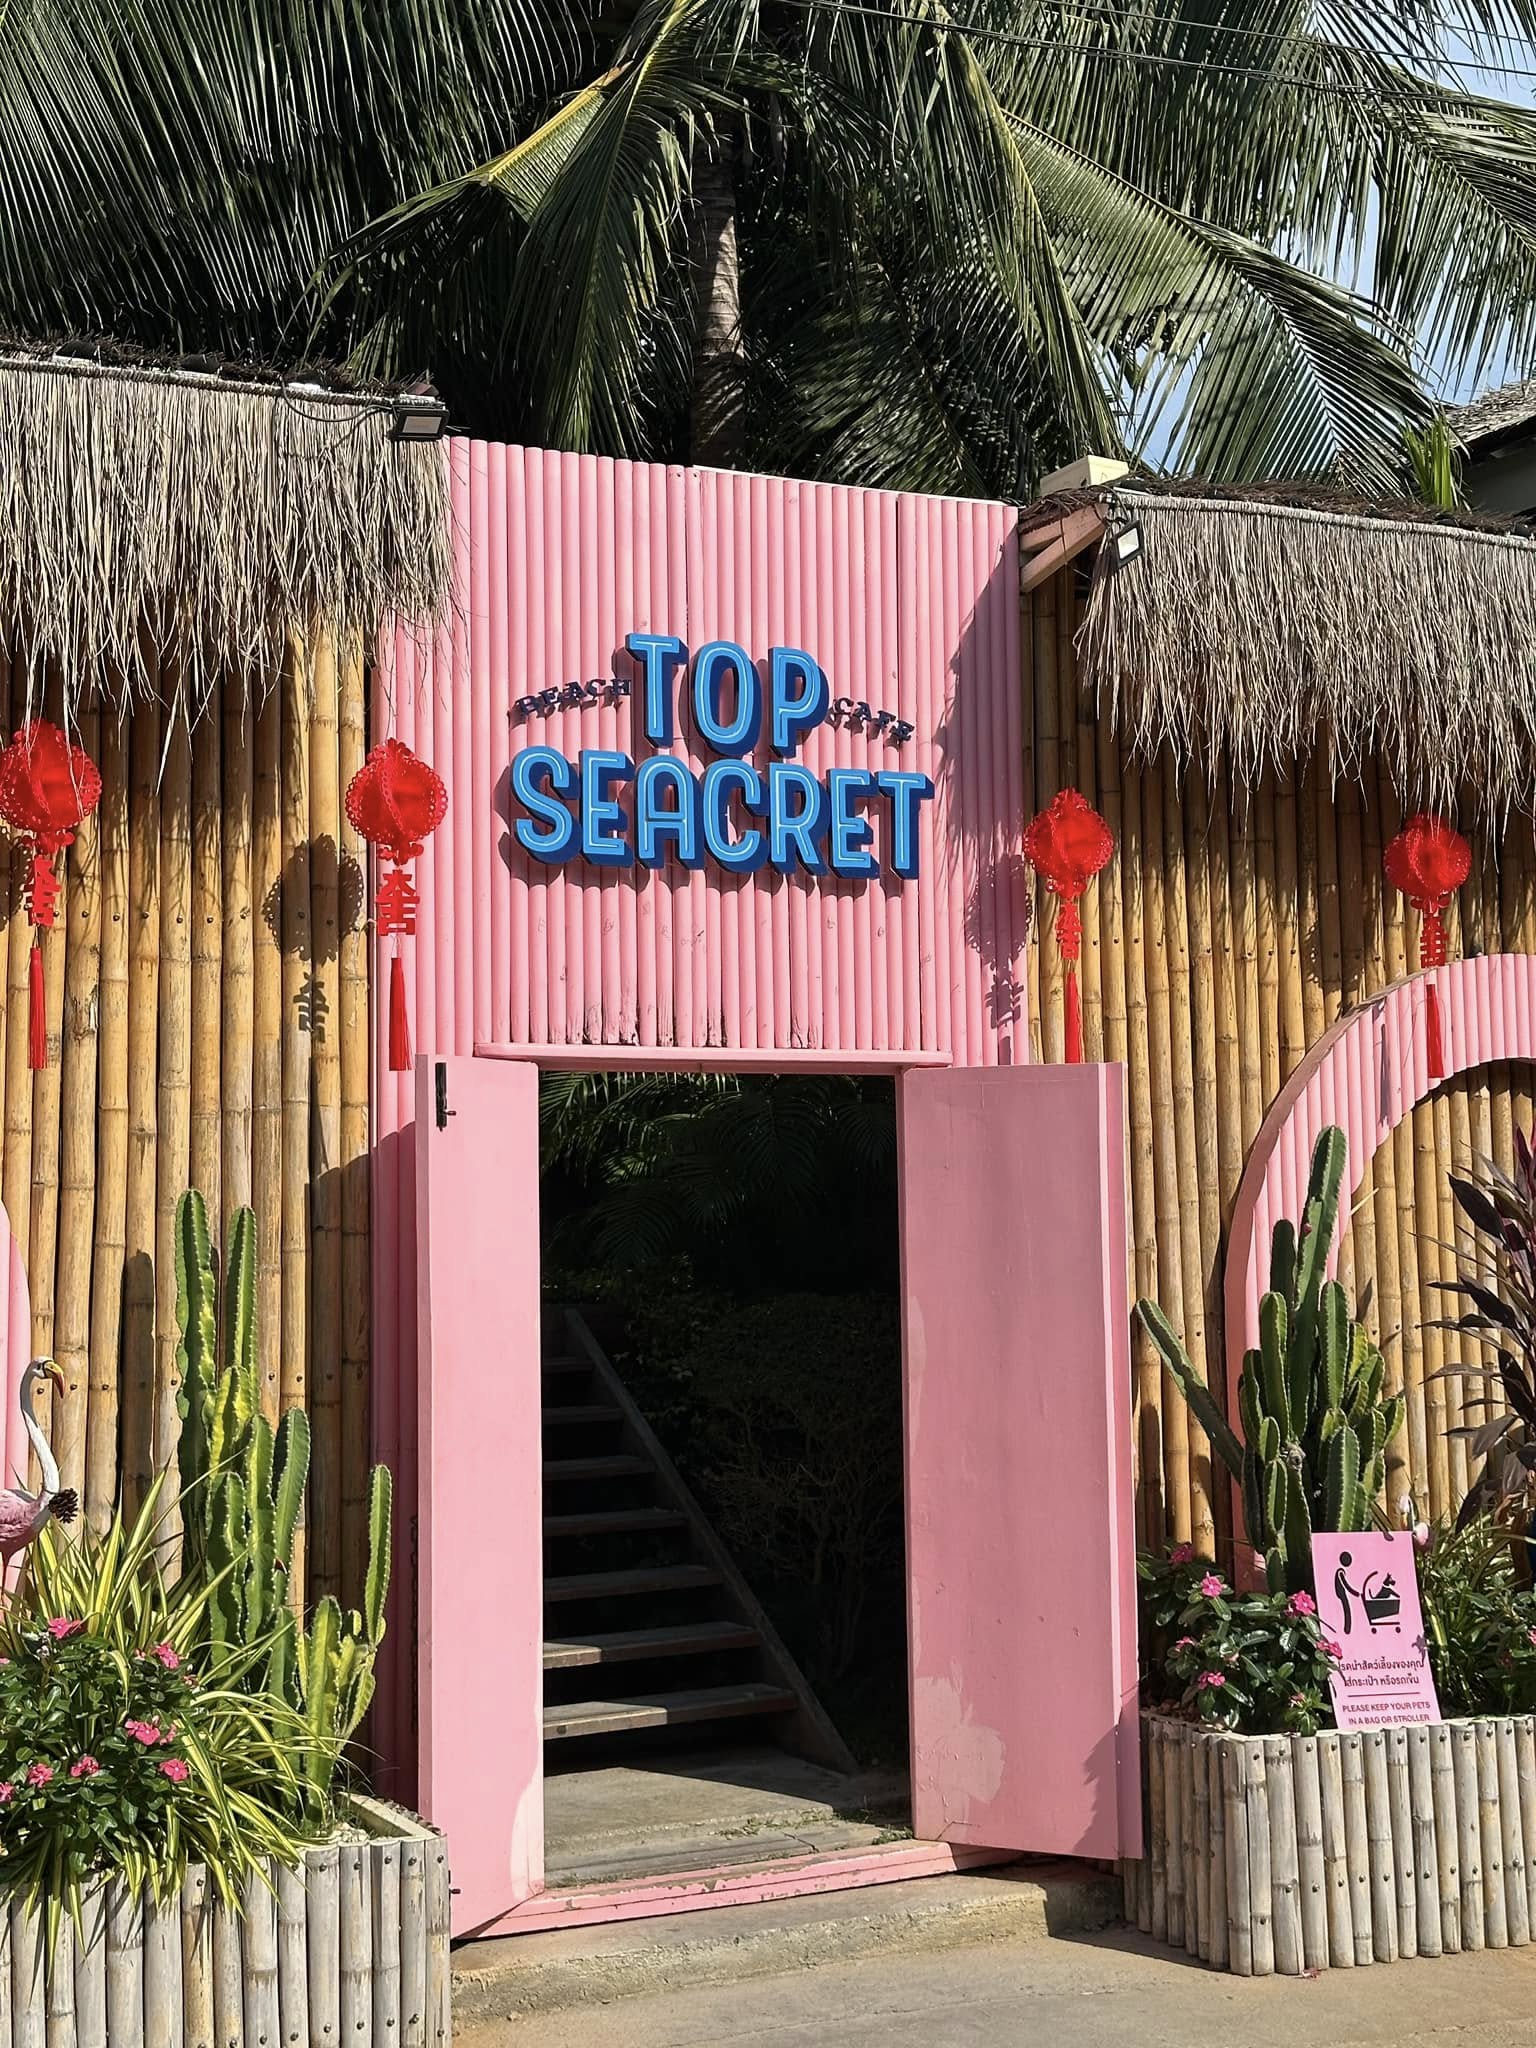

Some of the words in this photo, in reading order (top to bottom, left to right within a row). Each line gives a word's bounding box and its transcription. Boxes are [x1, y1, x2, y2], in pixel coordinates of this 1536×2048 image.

[514, 678, 632, 716] BEACH
[625, 632, 830, 758] TOP
[834, 697, 915, 742] CAFE
[511, 745, 935, 880] SEACRET
[1338, 1656, 1425, 1671] รดนำสัตว์เลี้ยงของคุณ
[1342, 1703, 1370, 1712] PLEASE
[1370, 1703, 1390, 1711] KEEP
[1389, 1702, 1412, 1711] YOUR
[1412, 1701, 1431, 1710] PETS
[1348, 1717, 1357, 1725] IN
[1364, 1716, 1381, 1725] BAG
[1393, 1714, 1431, 1723] STROLLER
